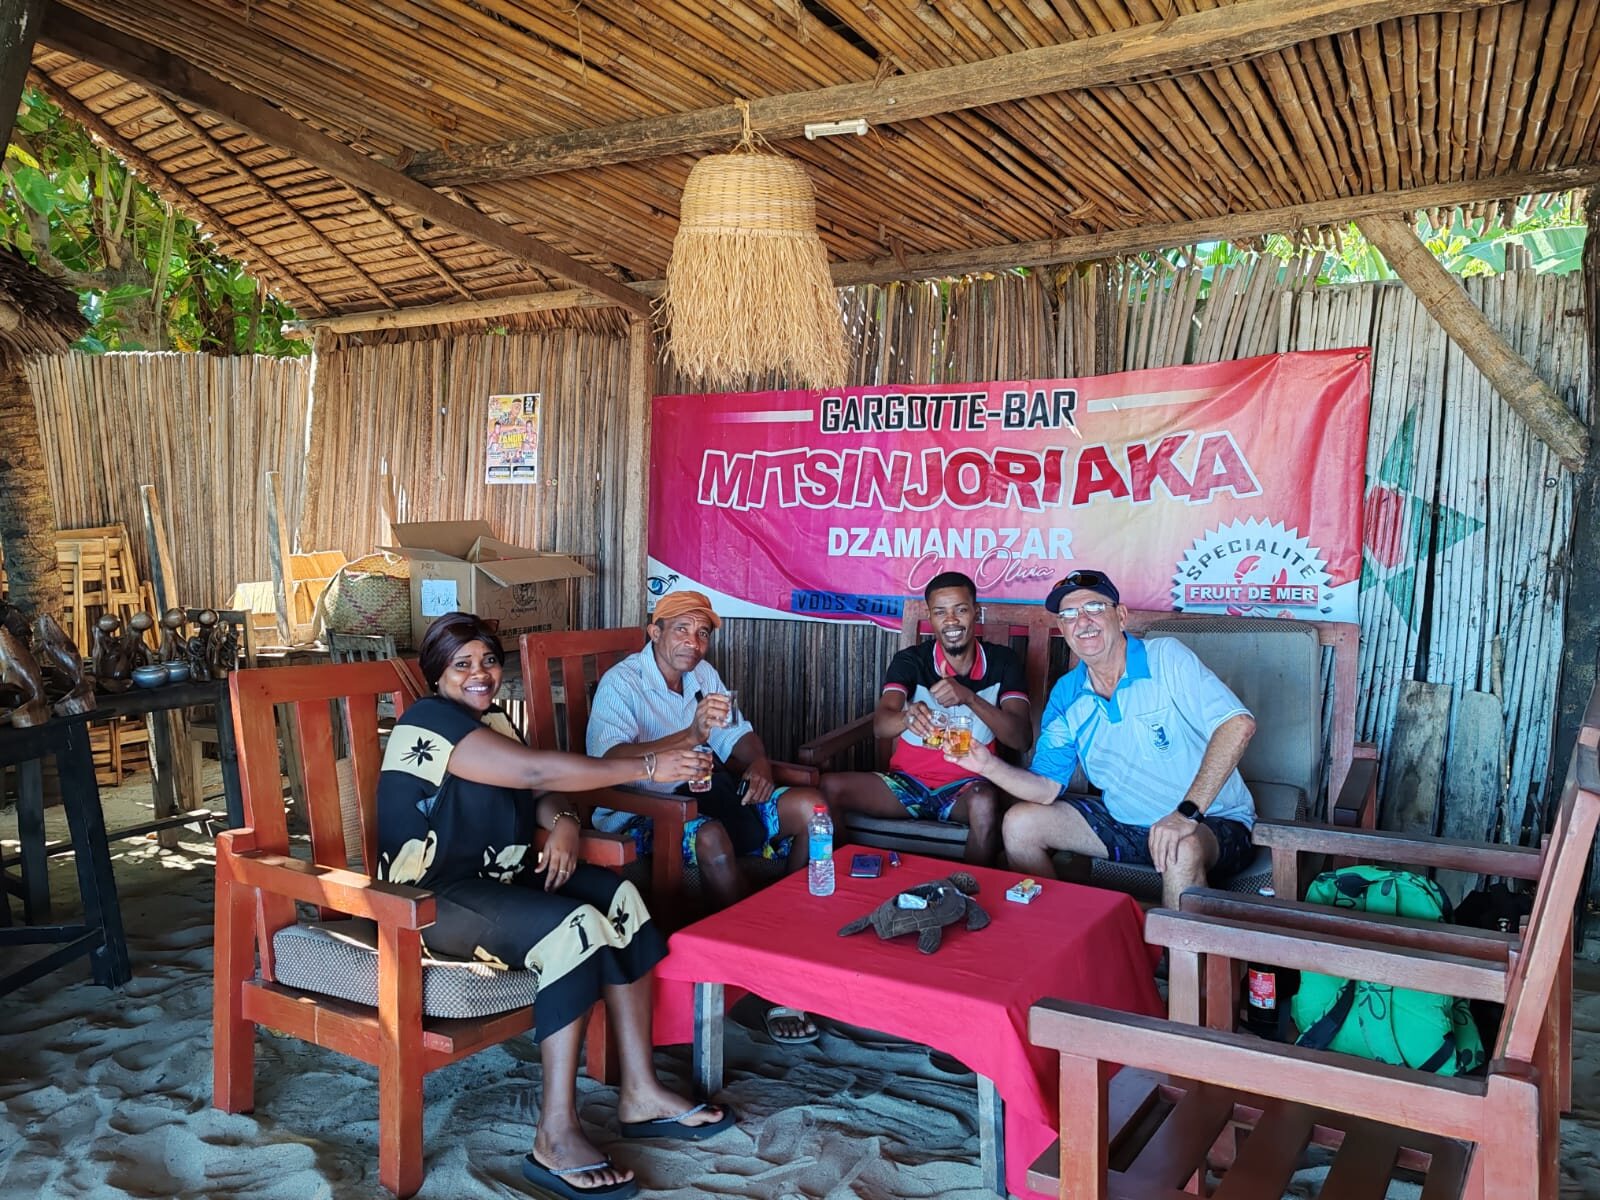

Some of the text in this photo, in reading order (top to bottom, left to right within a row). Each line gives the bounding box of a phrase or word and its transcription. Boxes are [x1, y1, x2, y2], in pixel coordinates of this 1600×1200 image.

[821, 389, 1078, 434] GARGOTTE-BAR
[828, 527, 1075, 560] DZAMANDZAR
[1186, 538, 1316, 581] SPECIALITE
[975, 546, 1056, 590] Olivia
[797, 593, 846, 611] VOUS
[1190, 586, 1317, 601] FRUIT DE MER
